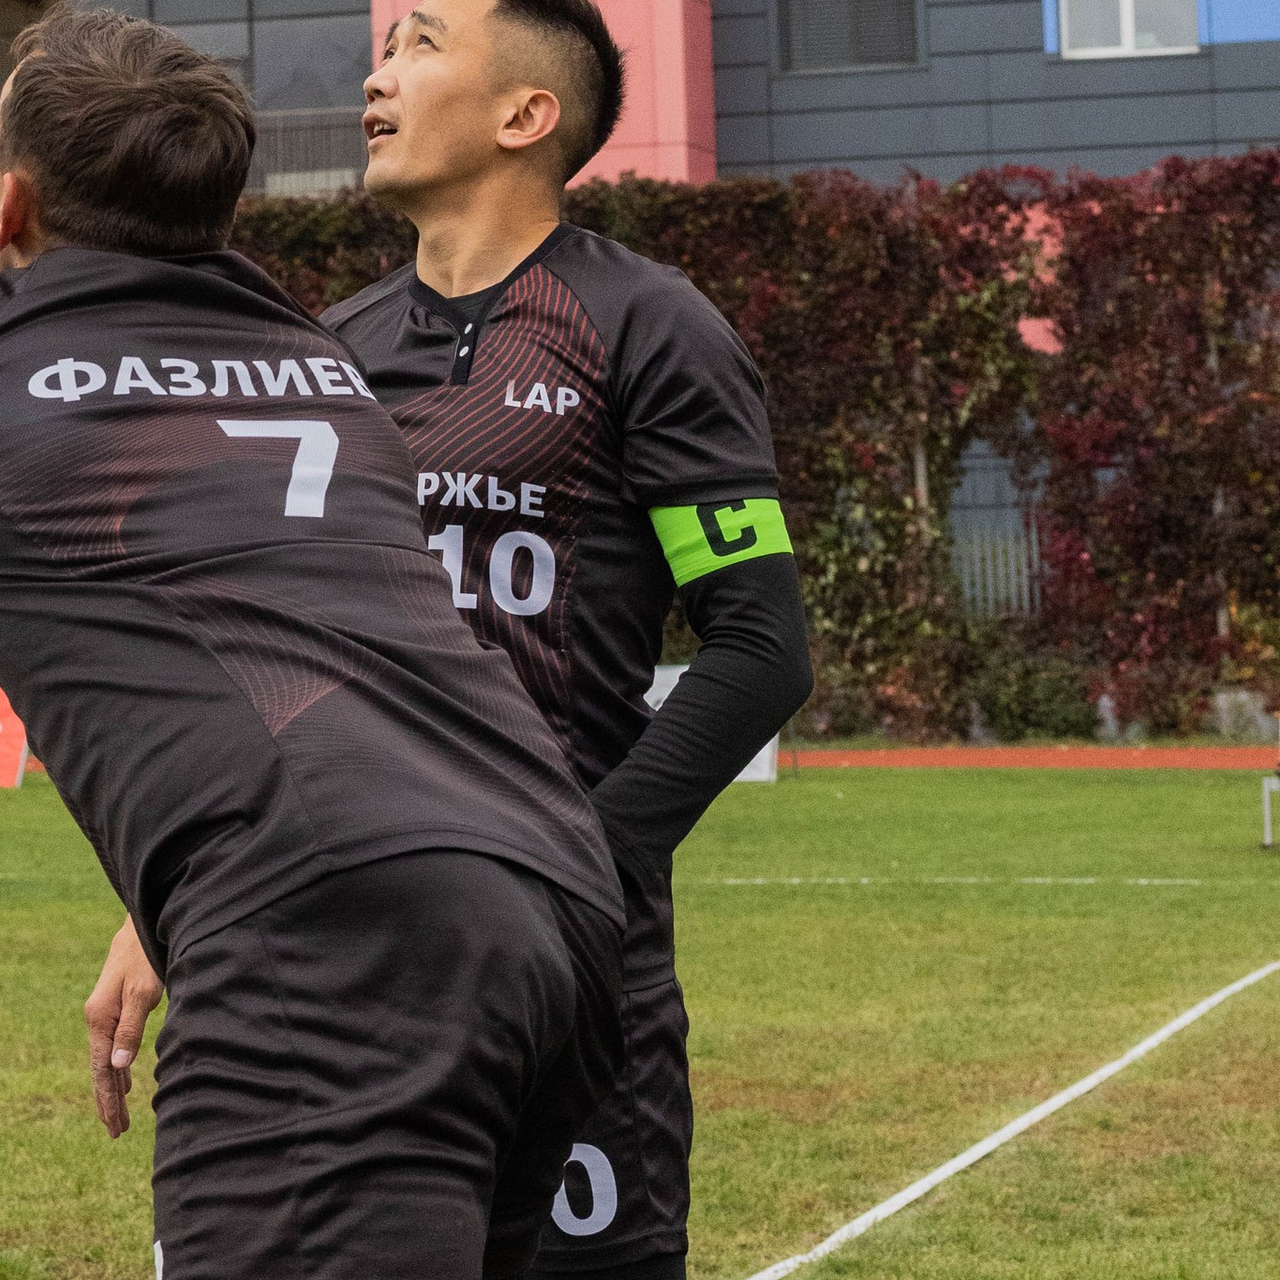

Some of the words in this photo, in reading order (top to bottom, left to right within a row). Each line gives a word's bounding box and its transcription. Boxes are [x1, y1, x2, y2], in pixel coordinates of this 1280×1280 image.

[504, 380, 580, 416] LAP
[216, 420, 340, 517] 7
[417, 471, 547, 518] РЖЬЕ
[428, 524, 556, 616] 10
[551, 1143, 618, 1236] 0
